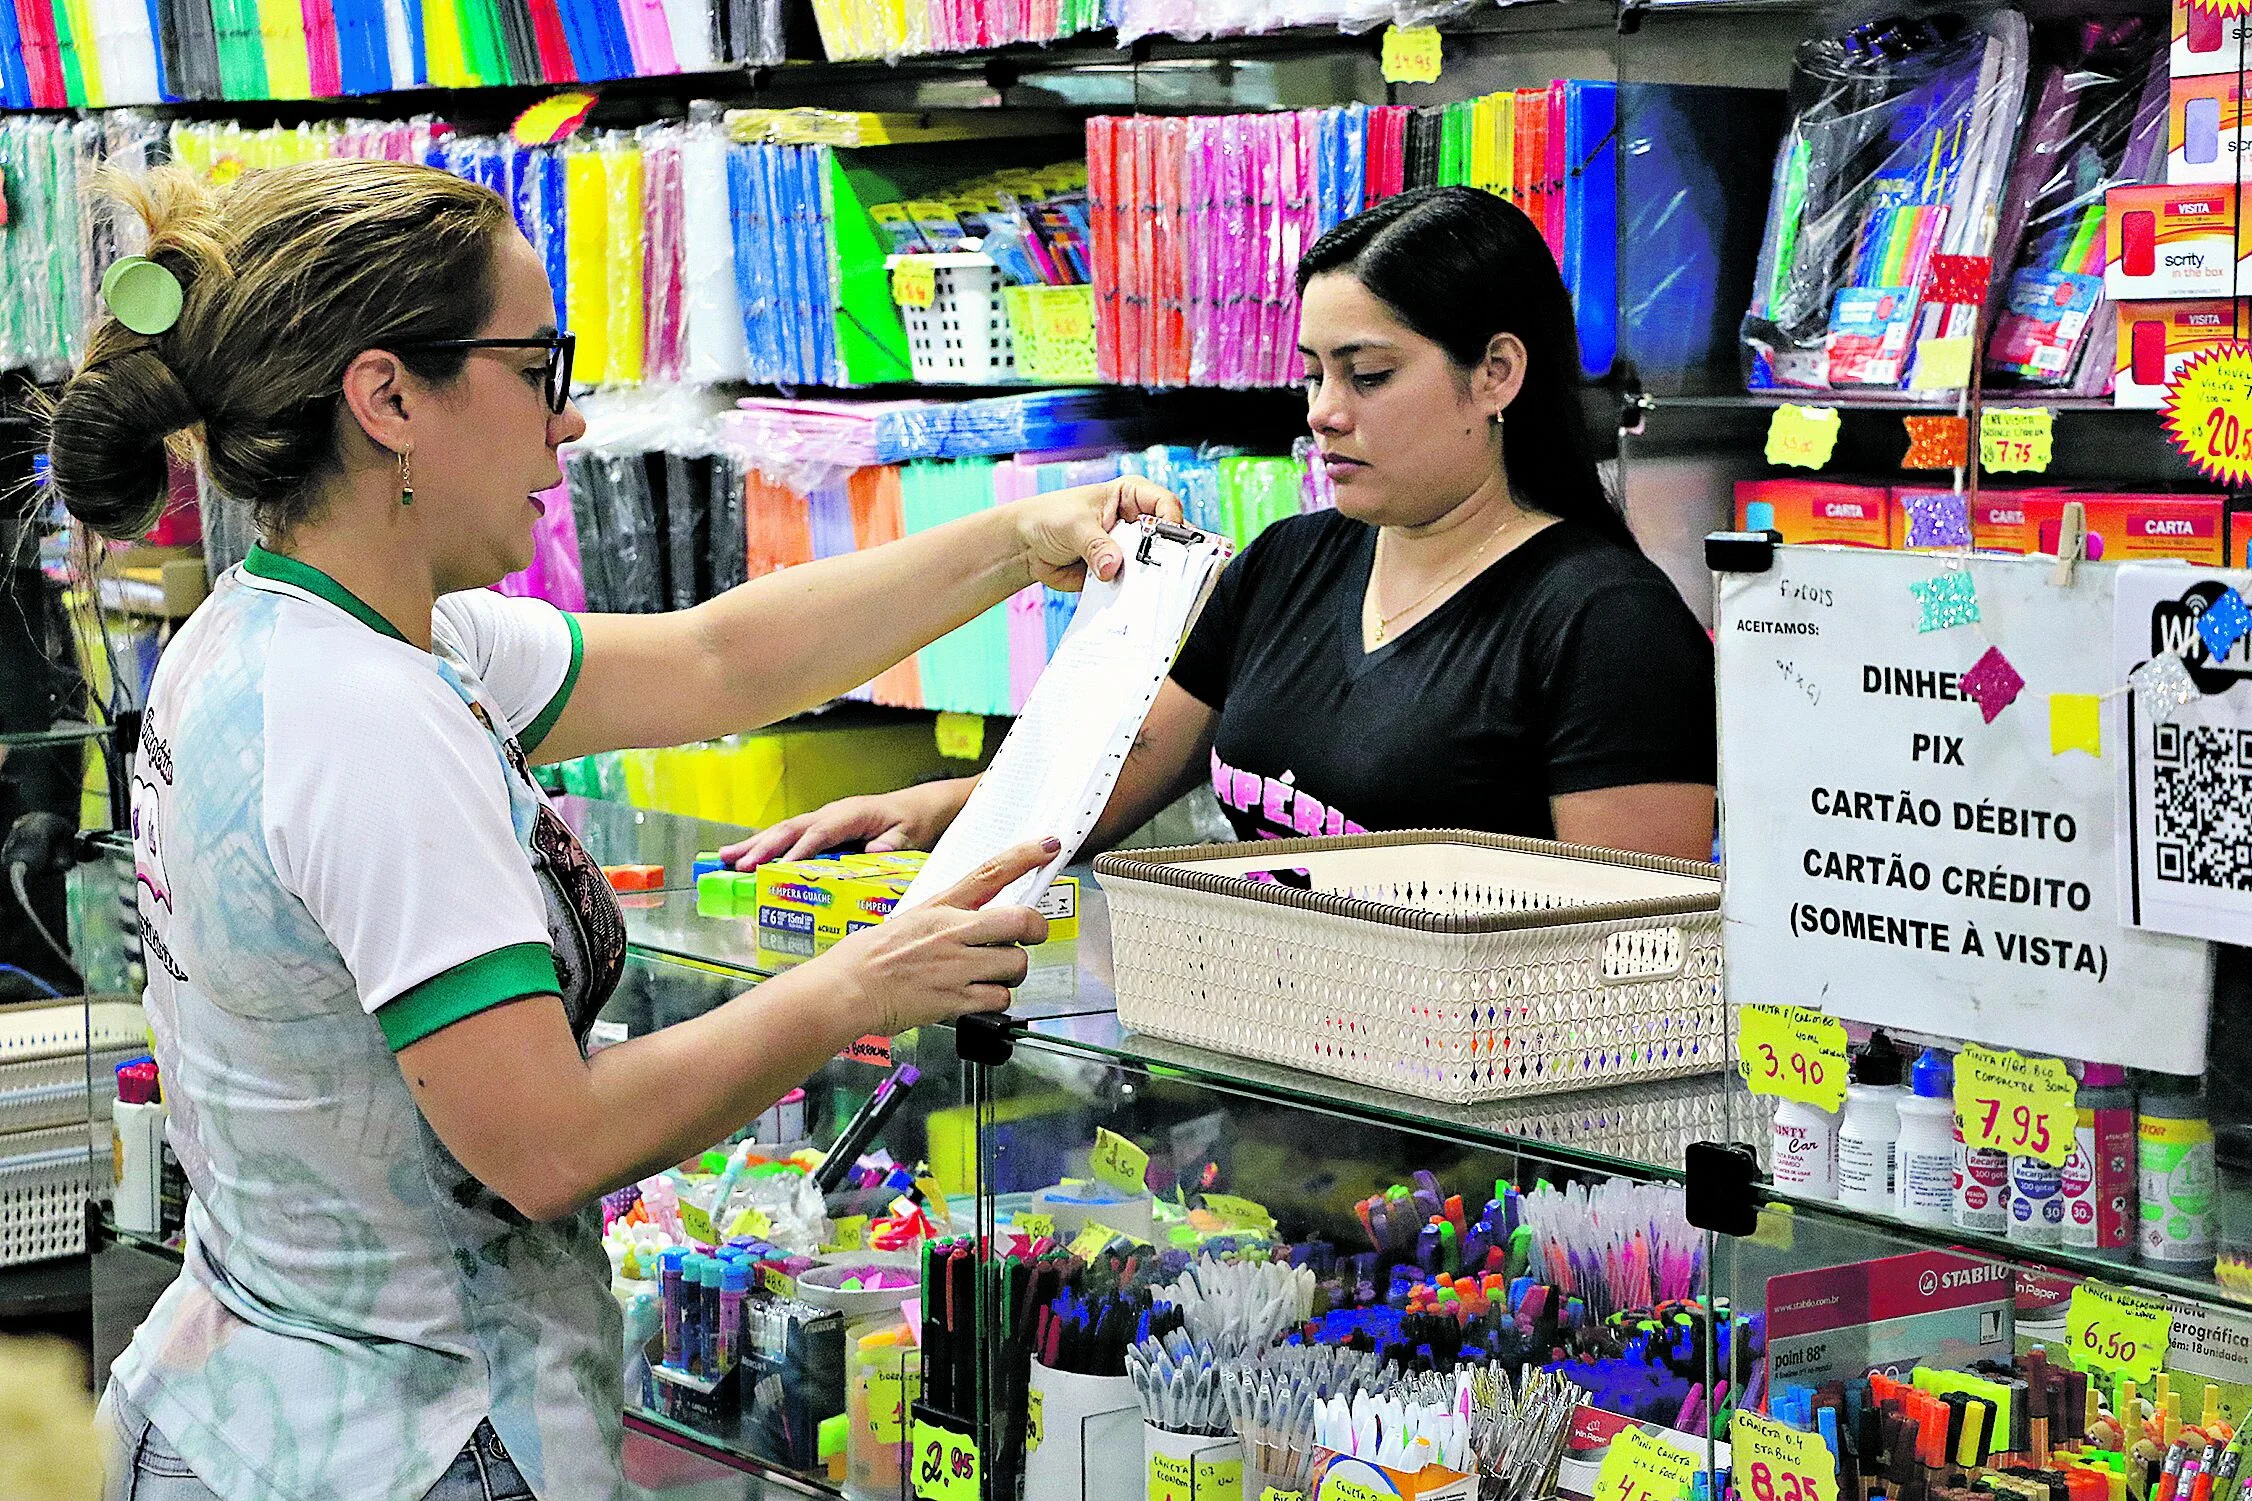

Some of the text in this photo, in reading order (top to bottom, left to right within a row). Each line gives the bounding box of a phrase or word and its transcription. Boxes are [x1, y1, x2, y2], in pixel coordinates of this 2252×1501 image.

[2178, 203, 2210, 214] VISITA
[2165, 252, 2204, 268] scrity
[2185, 268, 2201, 278] the
[2205, 266, 2224, 277] box
[2189, 315, 2221, 325] VISITA
[1996, 441, 2032, 463] 7.75
[1825, 504, 1864, 518] CARTA
[2145, 520, 2194, 535] CARTA
[1736, 619, 1820, 635] ACEITAMOS:
[1912, 733, 1965, 766] PIX
[1811, 787, 2077, 842] CARTÃO DÉBITO
[1803, 849, 2091, 911] CARTÃO CRÉDITO
[768, 885, 832, 904] TEMPERA GUACHE
[770, 910, 777, 925] 6
[787, 912, 804, 926] 15ml
[1790, 903, 2108, 983] (SOMENTE À VISTA)
[1758, 1043, 1824, 1085] 3.90
[1975, 1098, 2050, 1153] 7.95
[1789, 1138, 1818, 1153] Car
[2026, 1284, 2060, 1300] Paper
[1775, 1348, 1804, 1371] point
[1739, 1416, 1780, 1439] CANETA
[1631, 1433, 1690, 1466] MINI CANETA
[1754, 1443, 1801, 1465] STABILO
[922, 1440, 976, 1487] 2.95
[1154, 1456, 1188, 1474] CANETA
